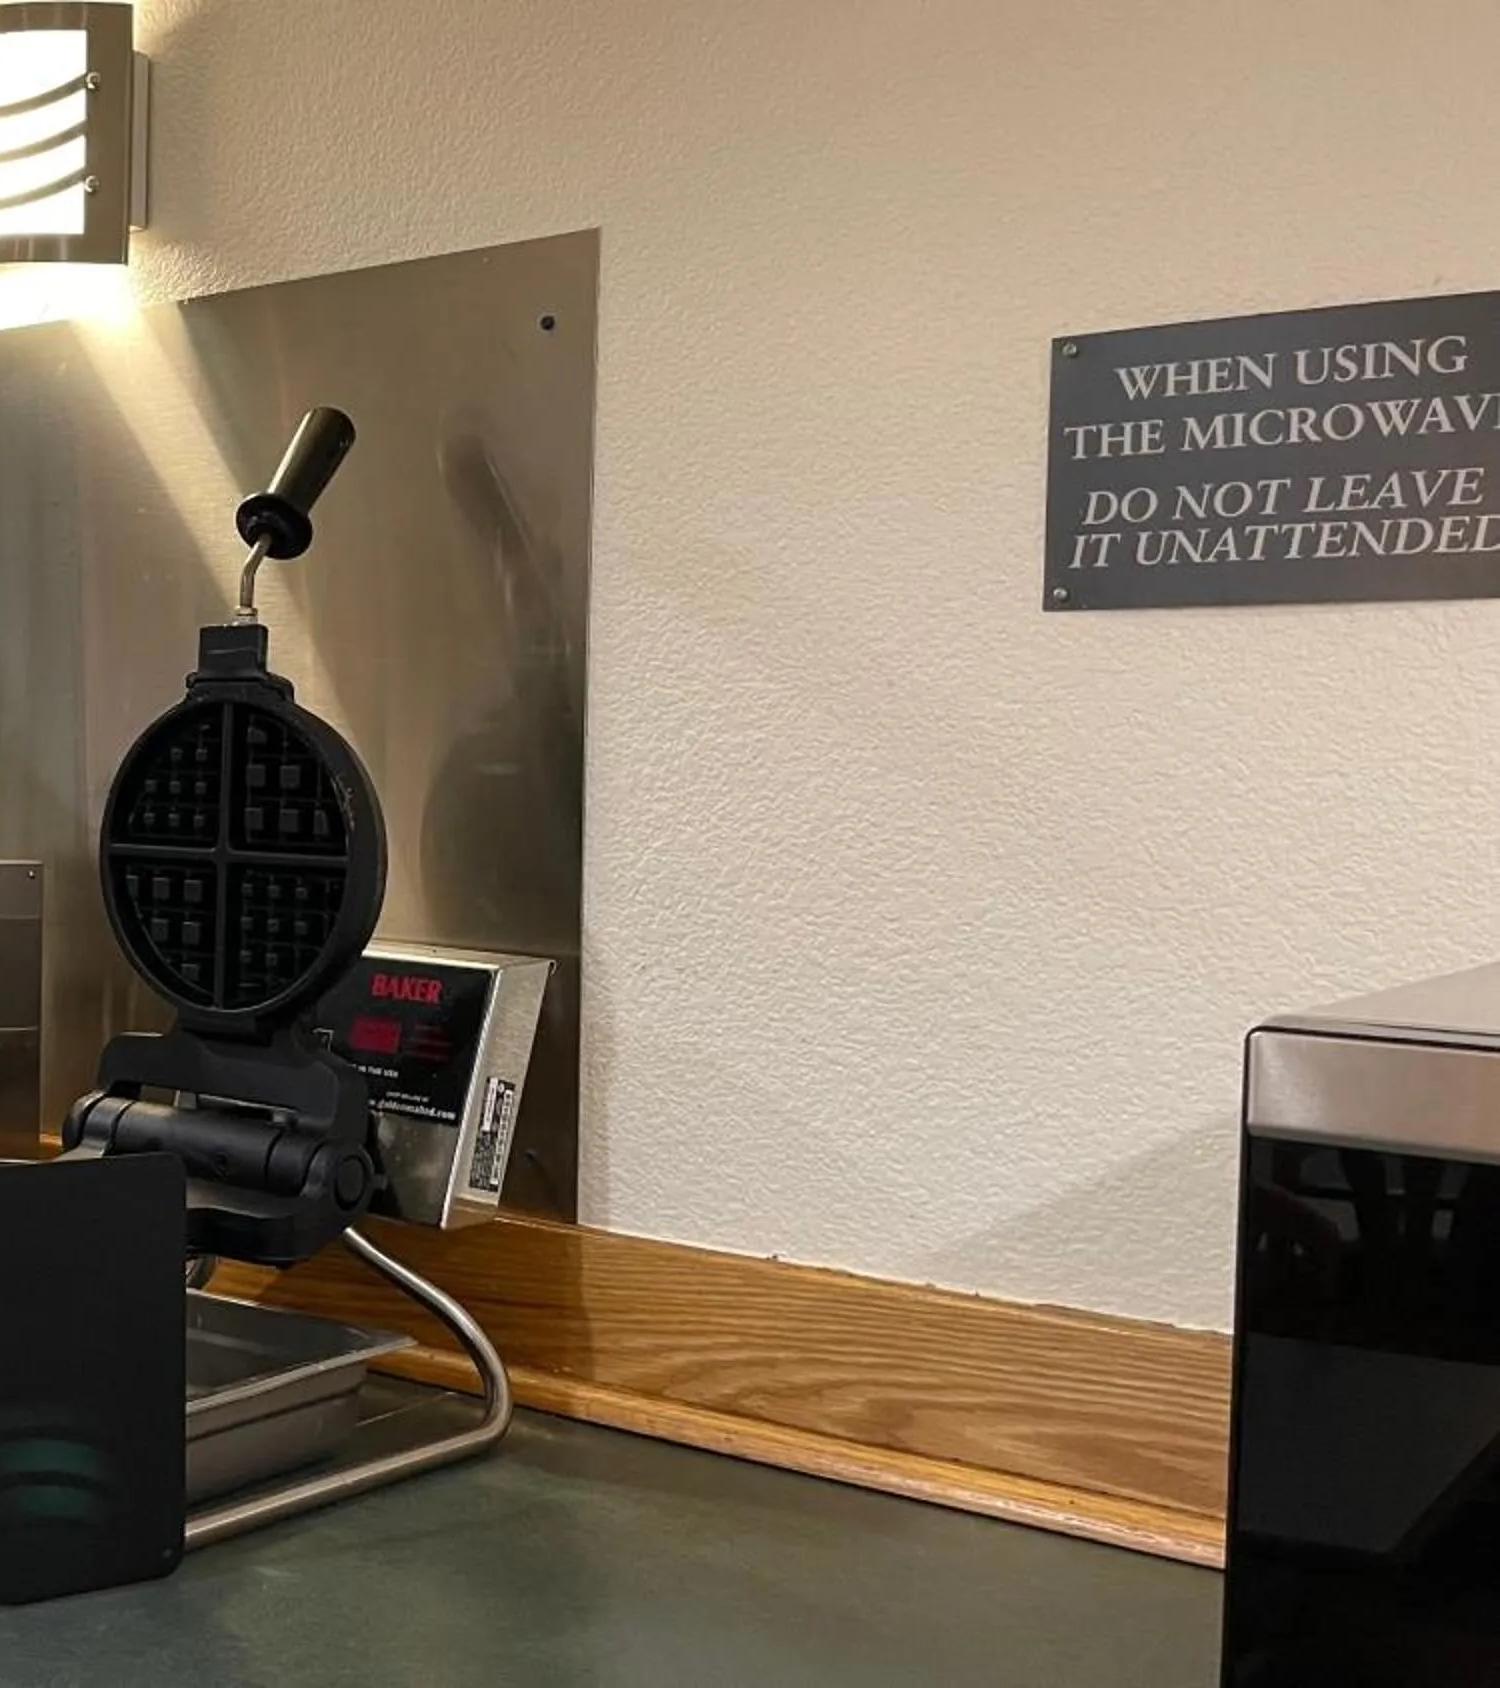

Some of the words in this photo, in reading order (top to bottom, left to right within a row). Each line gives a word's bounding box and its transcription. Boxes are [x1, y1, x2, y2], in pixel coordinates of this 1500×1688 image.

[1113, 352, 1279, 401] WHEN
[1294, 335, 1469, 386] USING
[1064, 418, 1165, 460] THE
[1082, 487, 1157, 526] DO
[1172, 478, 1291, 520] NOT
[1302, 467, 1485, 514] LEAVE
[1069, 533, 1121, 570] IT
[371, 974, 443, 1006] BAKER
